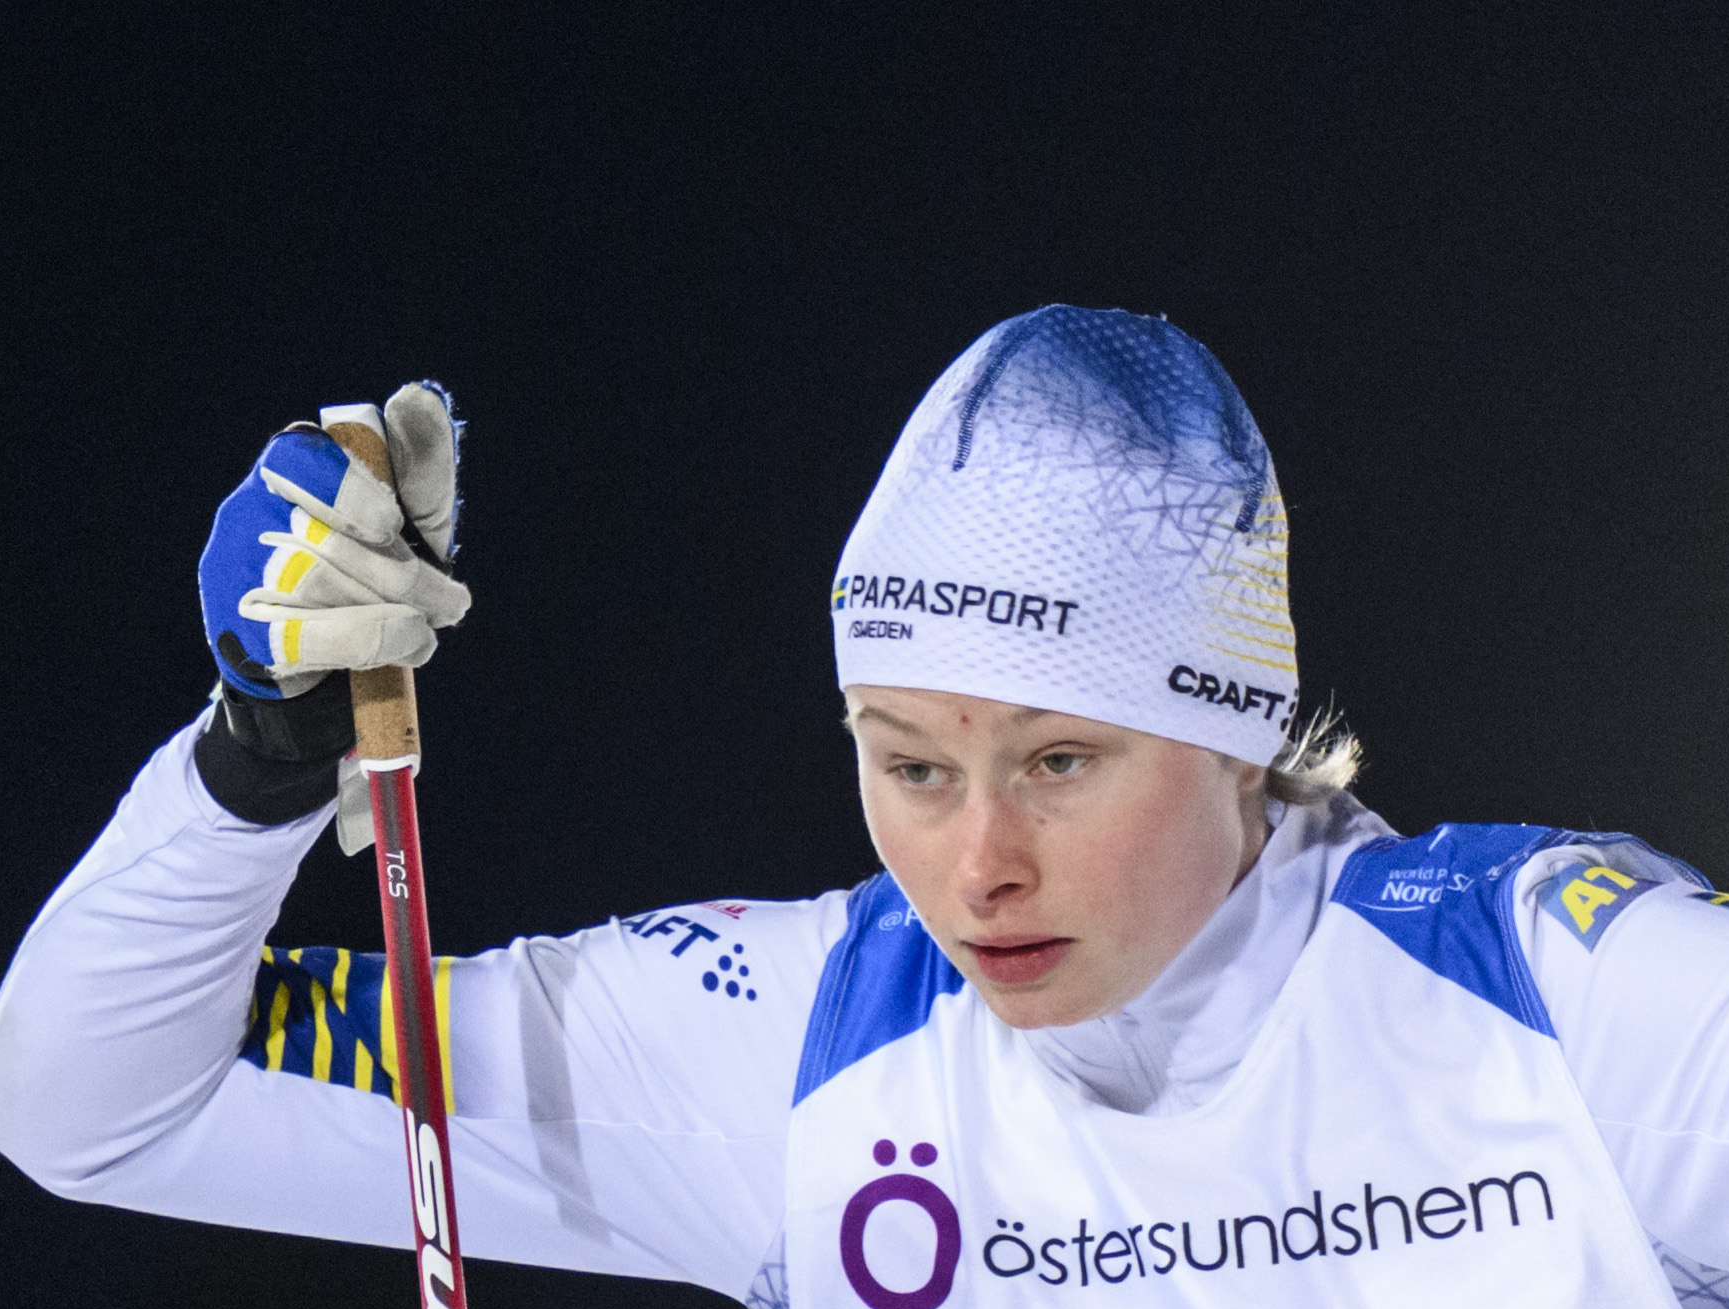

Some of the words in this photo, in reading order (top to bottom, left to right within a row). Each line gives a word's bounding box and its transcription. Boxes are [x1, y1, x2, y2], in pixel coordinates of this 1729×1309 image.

[849, 574, 1080, 636] PARASPORT
[1168, 664, 1286, 721] CRAFT
[1381, 881, 1445, 904] Nord
[620, 913, 720, 959] AFT
[981, 1169, 1555, 1289] östersundshem
